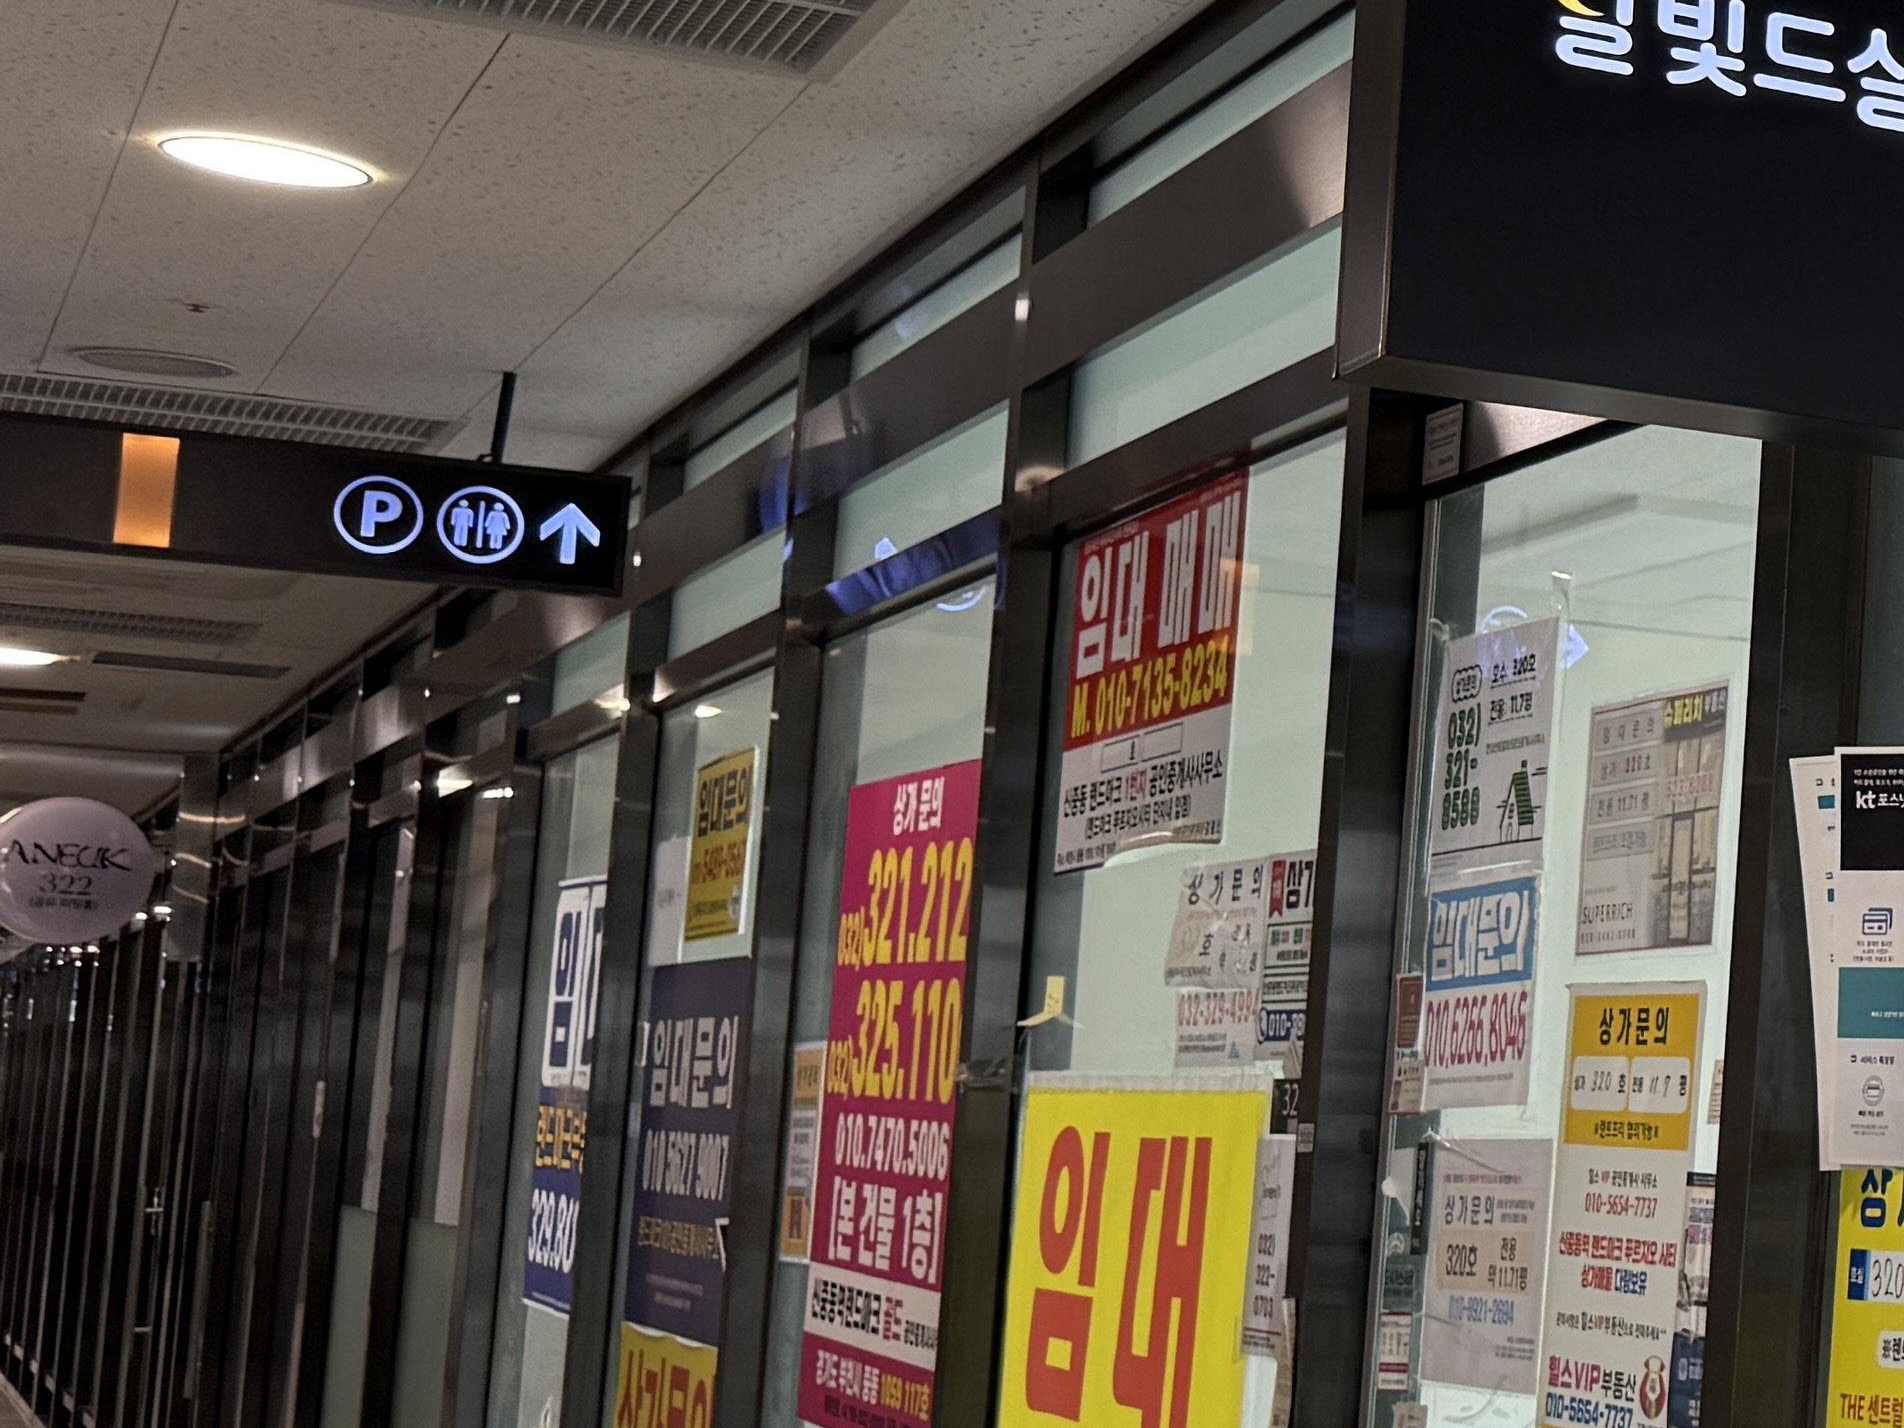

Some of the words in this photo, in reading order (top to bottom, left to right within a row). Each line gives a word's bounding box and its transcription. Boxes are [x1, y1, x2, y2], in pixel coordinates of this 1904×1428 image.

[1076, 530, 1149, 680] 임대
[1157, 490, 1241, 649] 매매
[1095, 634, 1229, 736] 010-7135-8234
[1448, 703, 1481, 750] 032)
[893, 781, 918, 836] 상가
[918, 776, 945, 831] 문의
[1856, 791, 1876, 809] kt
[39, 874, 92, 896] 322
[1431, 890, 1530, 981] 임대문의
[1599, 1007, 1670, 1046] 상가문의
[651, 1016, 739, 1109] 임대문의
[858, 1182, 896, 1271] 건물
[1446, 1243, 1478, 1277] 320호
[1871, 1257, 1904, 1299] 320
[1840, 1393, 1866, 1420] THE
[1867, 1394, 1903, 1428] 센트럴
